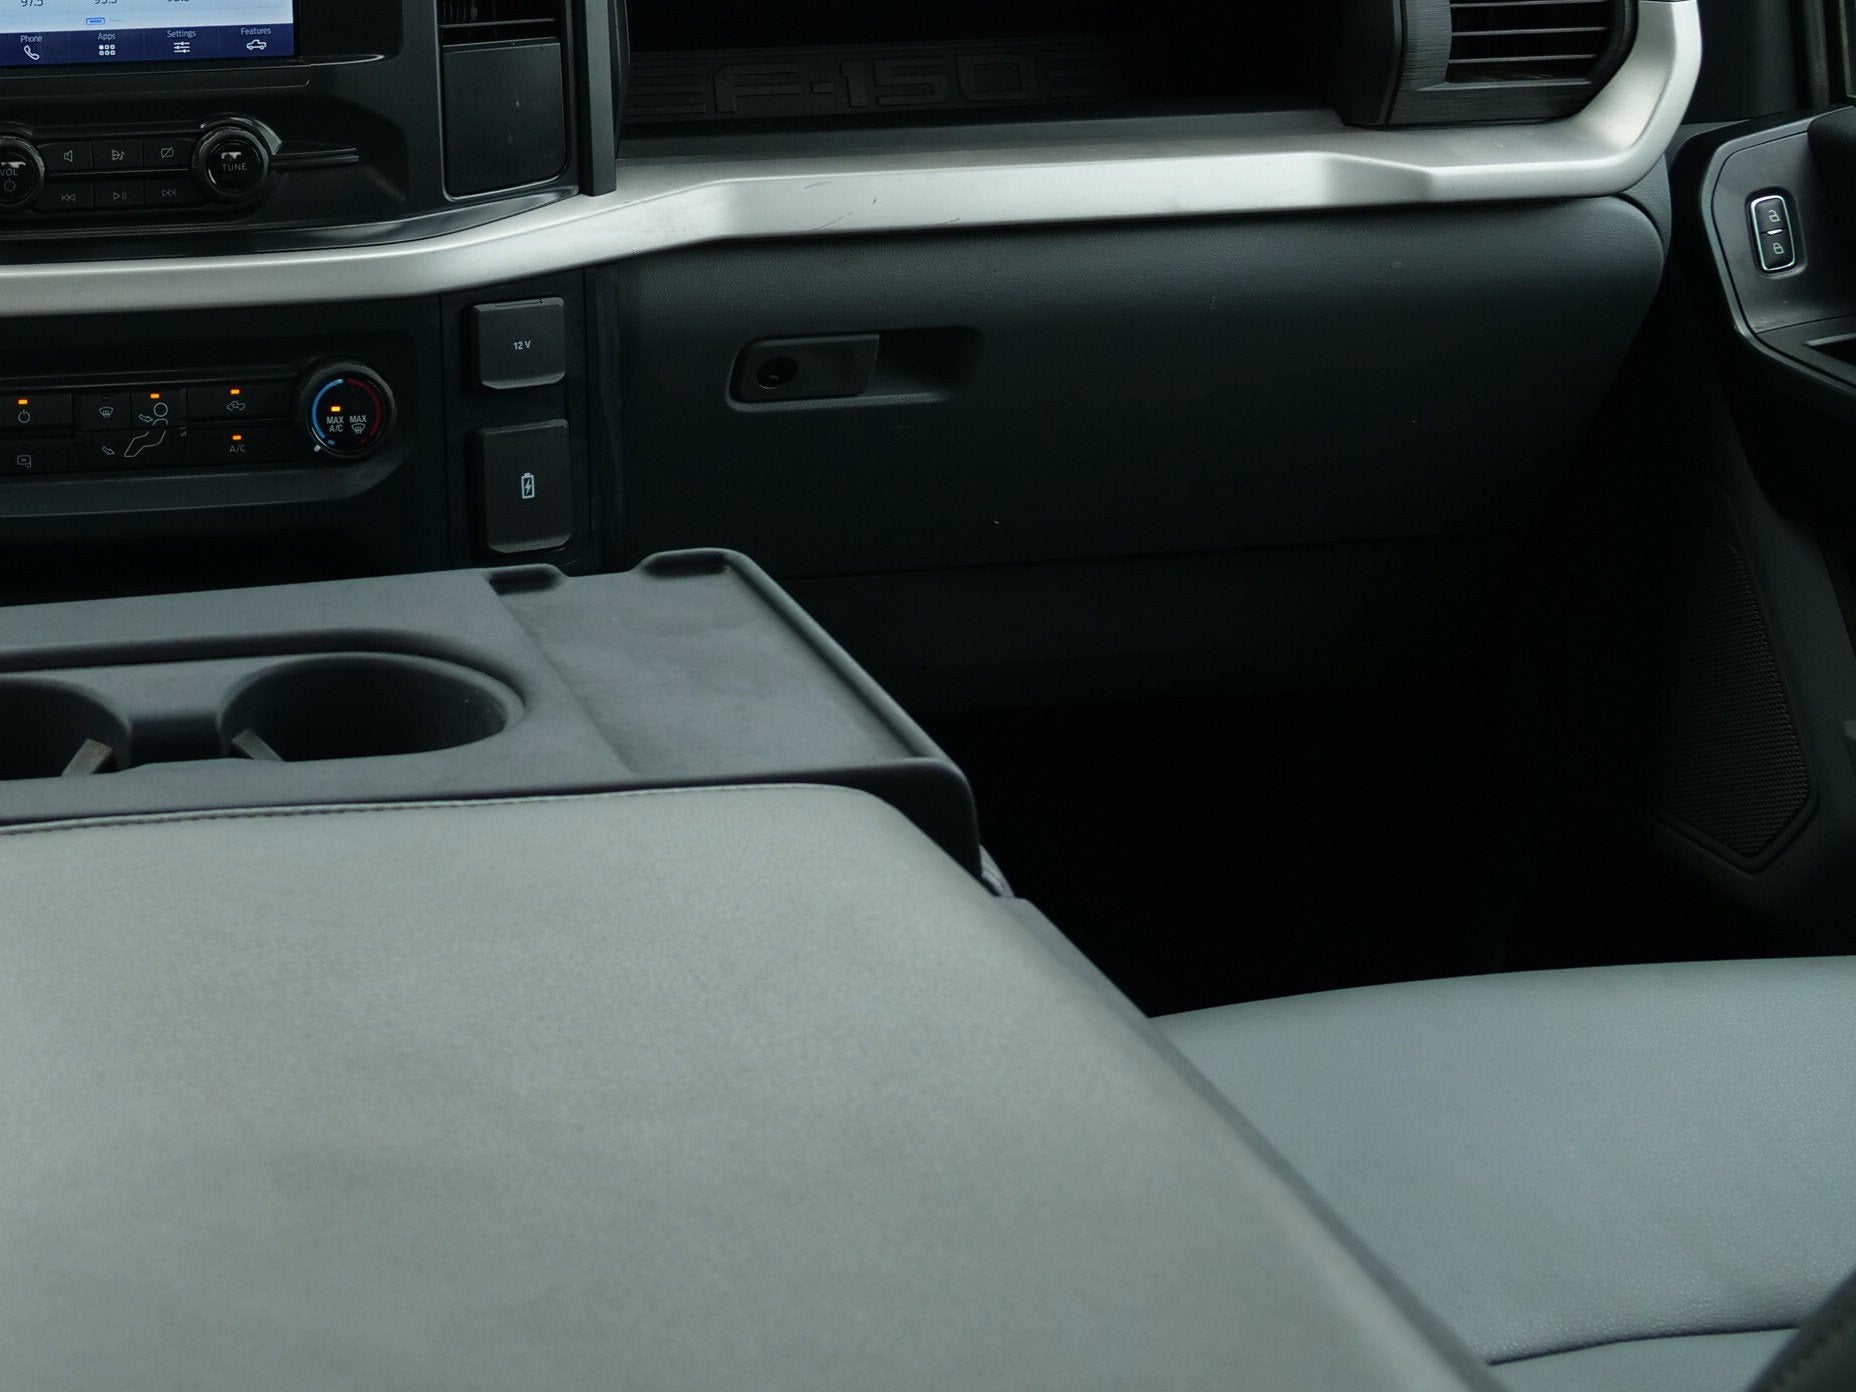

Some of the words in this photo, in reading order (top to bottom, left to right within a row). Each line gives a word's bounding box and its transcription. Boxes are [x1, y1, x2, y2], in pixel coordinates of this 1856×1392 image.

[20, 34, 43, 43] Phone
[97, 32, 116, 41] Apps
[166, 29, 196, 39] Settings
[240, 26, 271, 36] Features
[222, 162, 247, 172] TUNE
[0, 168, 19, 177] VOL
[513, 341, 523, 350] 12
[524, 340, 531, 349] V
[326, 415, 344, 424] MAX
[349, 414, 367, 423] MAX
[329, 423, 343, 433] A/C
[229, 444, 246, 453] A/C
